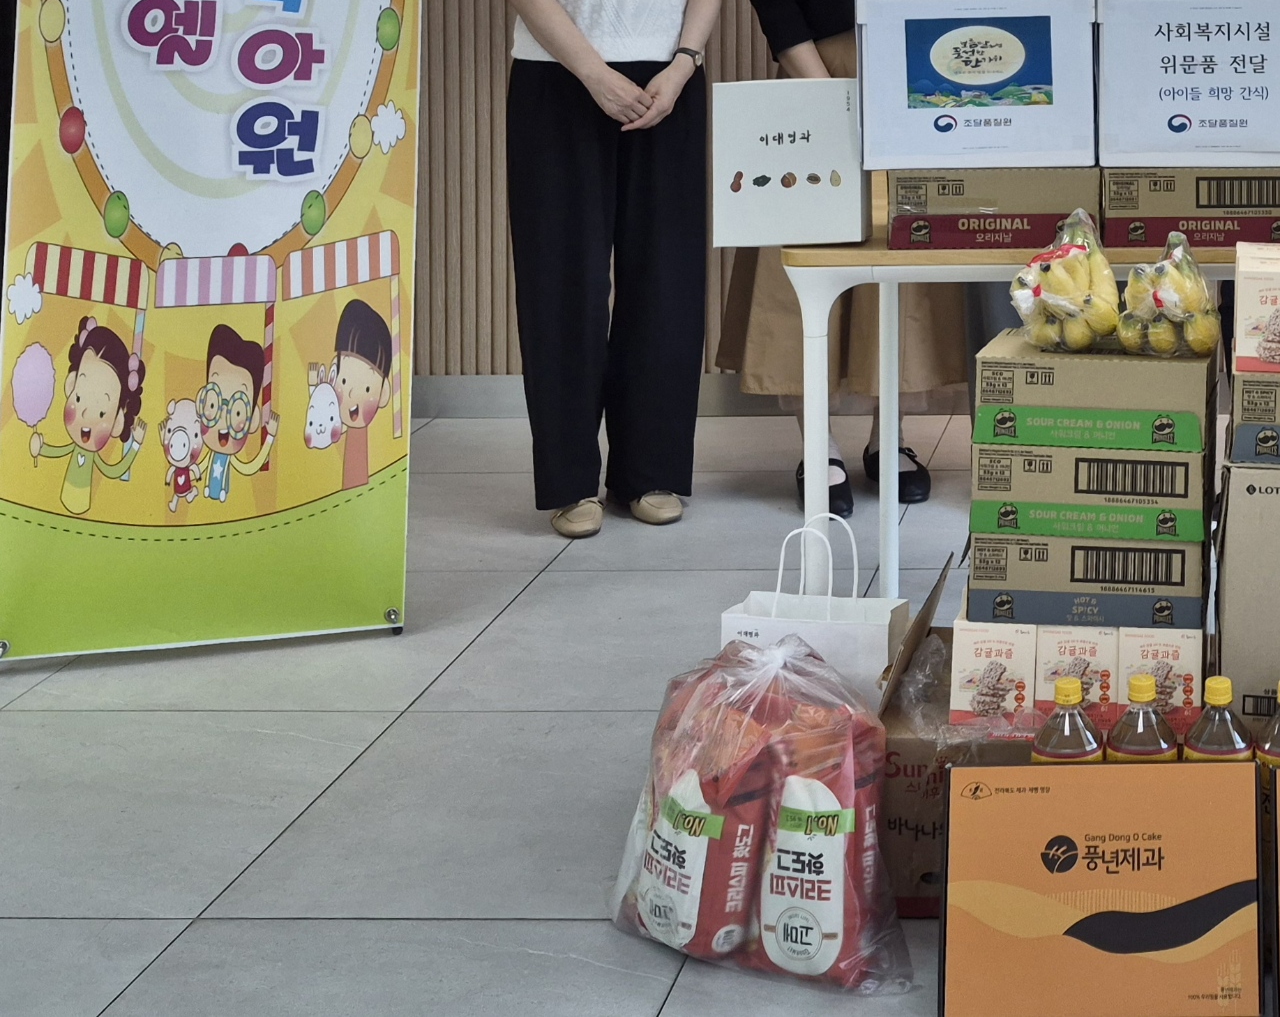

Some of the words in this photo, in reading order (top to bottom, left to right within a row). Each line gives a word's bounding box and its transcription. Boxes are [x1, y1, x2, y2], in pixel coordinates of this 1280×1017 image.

[1154, 21, 1271, 42] 사회복지시설
[1159, 54, 1219, 75] 위문품
[1229, 54, 1268, 74] 전달
[1158, 87, 1202, 102] (아이들
[1208, 86, 1235, 101] 희망
[1239, 85, 1269, 101] 간식)
[963, 118, 1012, 128] 조달품질원
[1198, 118, 1248, 128] 조달품질원
[958, 218, 1031, 231] ORIGINAL
[1178, 220, 1241, 231] ORIGINAL
[975, 233, 1013, 243] 오리지날
[1193, 232, 1225, 242] 오리지날
[1026, 417, 1054, 427] SOUR
[1057, 418, 1093, 428] CREAM
[1106, 420, 1141, 430] ONION
[1028, 509, 1057, 519] SOUR
[1060, 510, 1096, 521] CREAM
[1109, 513, 1145, 523] ONION
[1074, 597, 1090, 605] HOT
[1072, 606, 1099, 614] SPICY
[805, 814, 840, 837] No.1
[1084, 834, 1106, 844] Gang
[1108, 833, 1131, 843] Dong
[1141, 832, 1162, 841] Cake
[776, 848, 825, 876] 핫도그
[1082, 845, 1165, 874] 풍년제과
[769, 873, 832, 903] 크리스피
[783, 923, 814, 947] 고메
